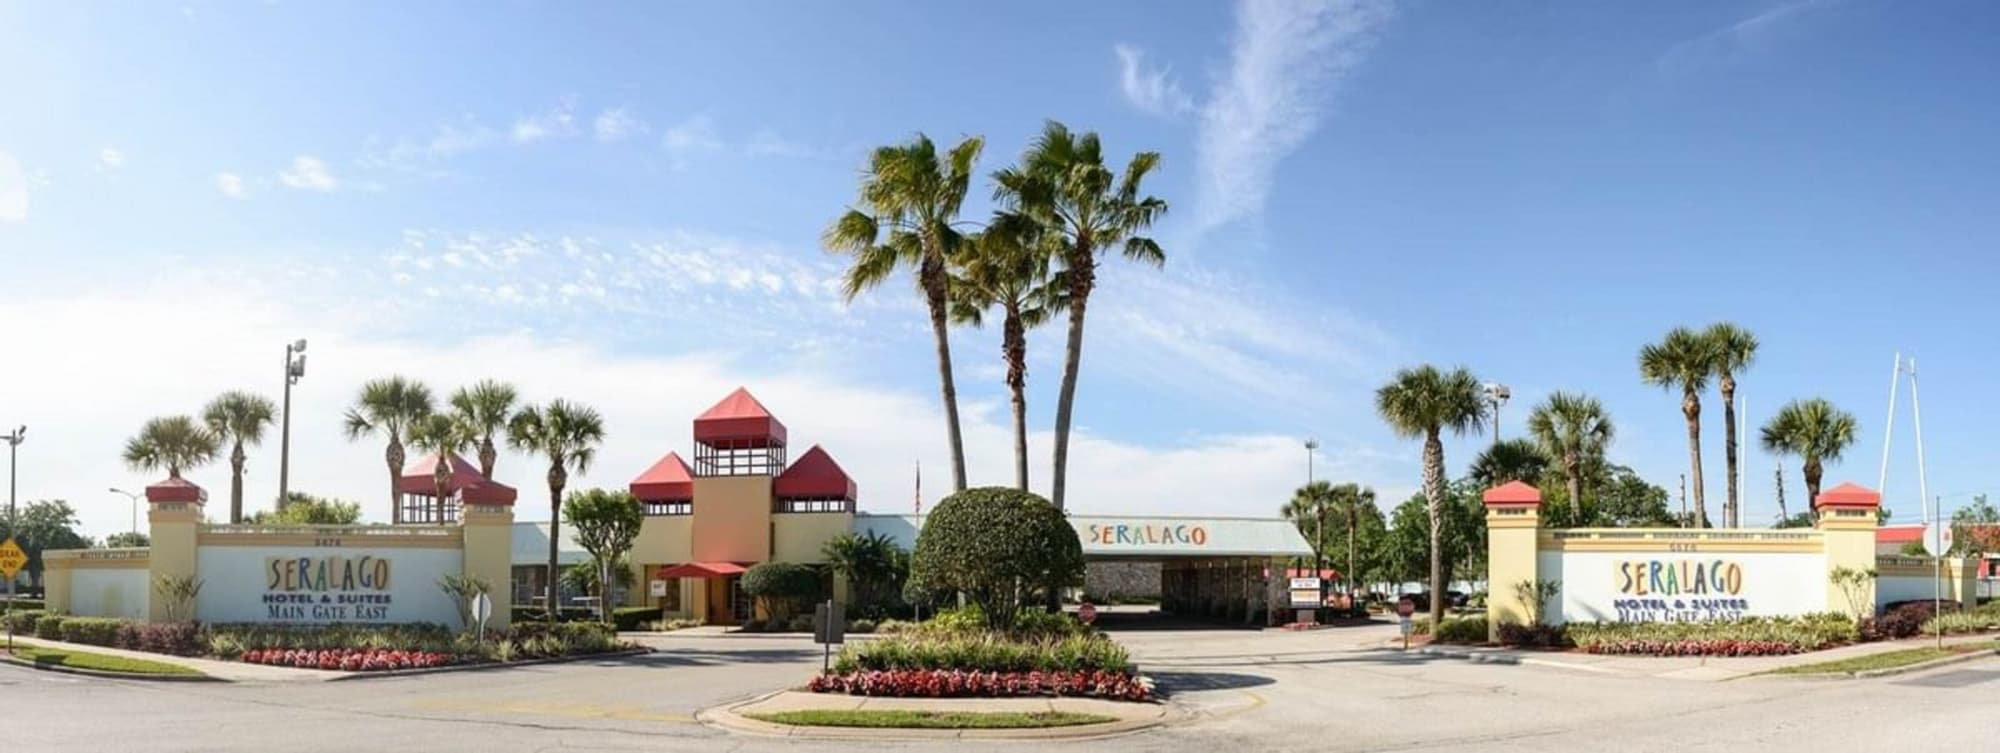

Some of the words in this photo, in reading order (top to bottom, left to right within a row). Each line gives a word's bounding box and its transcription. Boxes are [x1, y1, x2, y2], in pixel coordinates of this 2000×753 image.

[1089, 523, 1207, 546] SERALAGO
[268, 555, 389, 591] SERALAGO
[1620, 559, 1742, 596] SERALAGO
[262, 594, 314, 604] HOTEL
[320, 594, 332, 604] &
[337, 594, 392, 604] SUITES
[1614, 599, 1667, 609] HOTEL
[1674, 599, 1686, 609] &
[1691, 599, 1749, 609] SUITES
[268, 604, 305, 620] MAIN
[312, 604, 347, 620] GATE
[355, 604, 388, 620] EAST
[1617, 607, 1656, 623] MAIN
[1664, 607, 1699, 622] GATE
